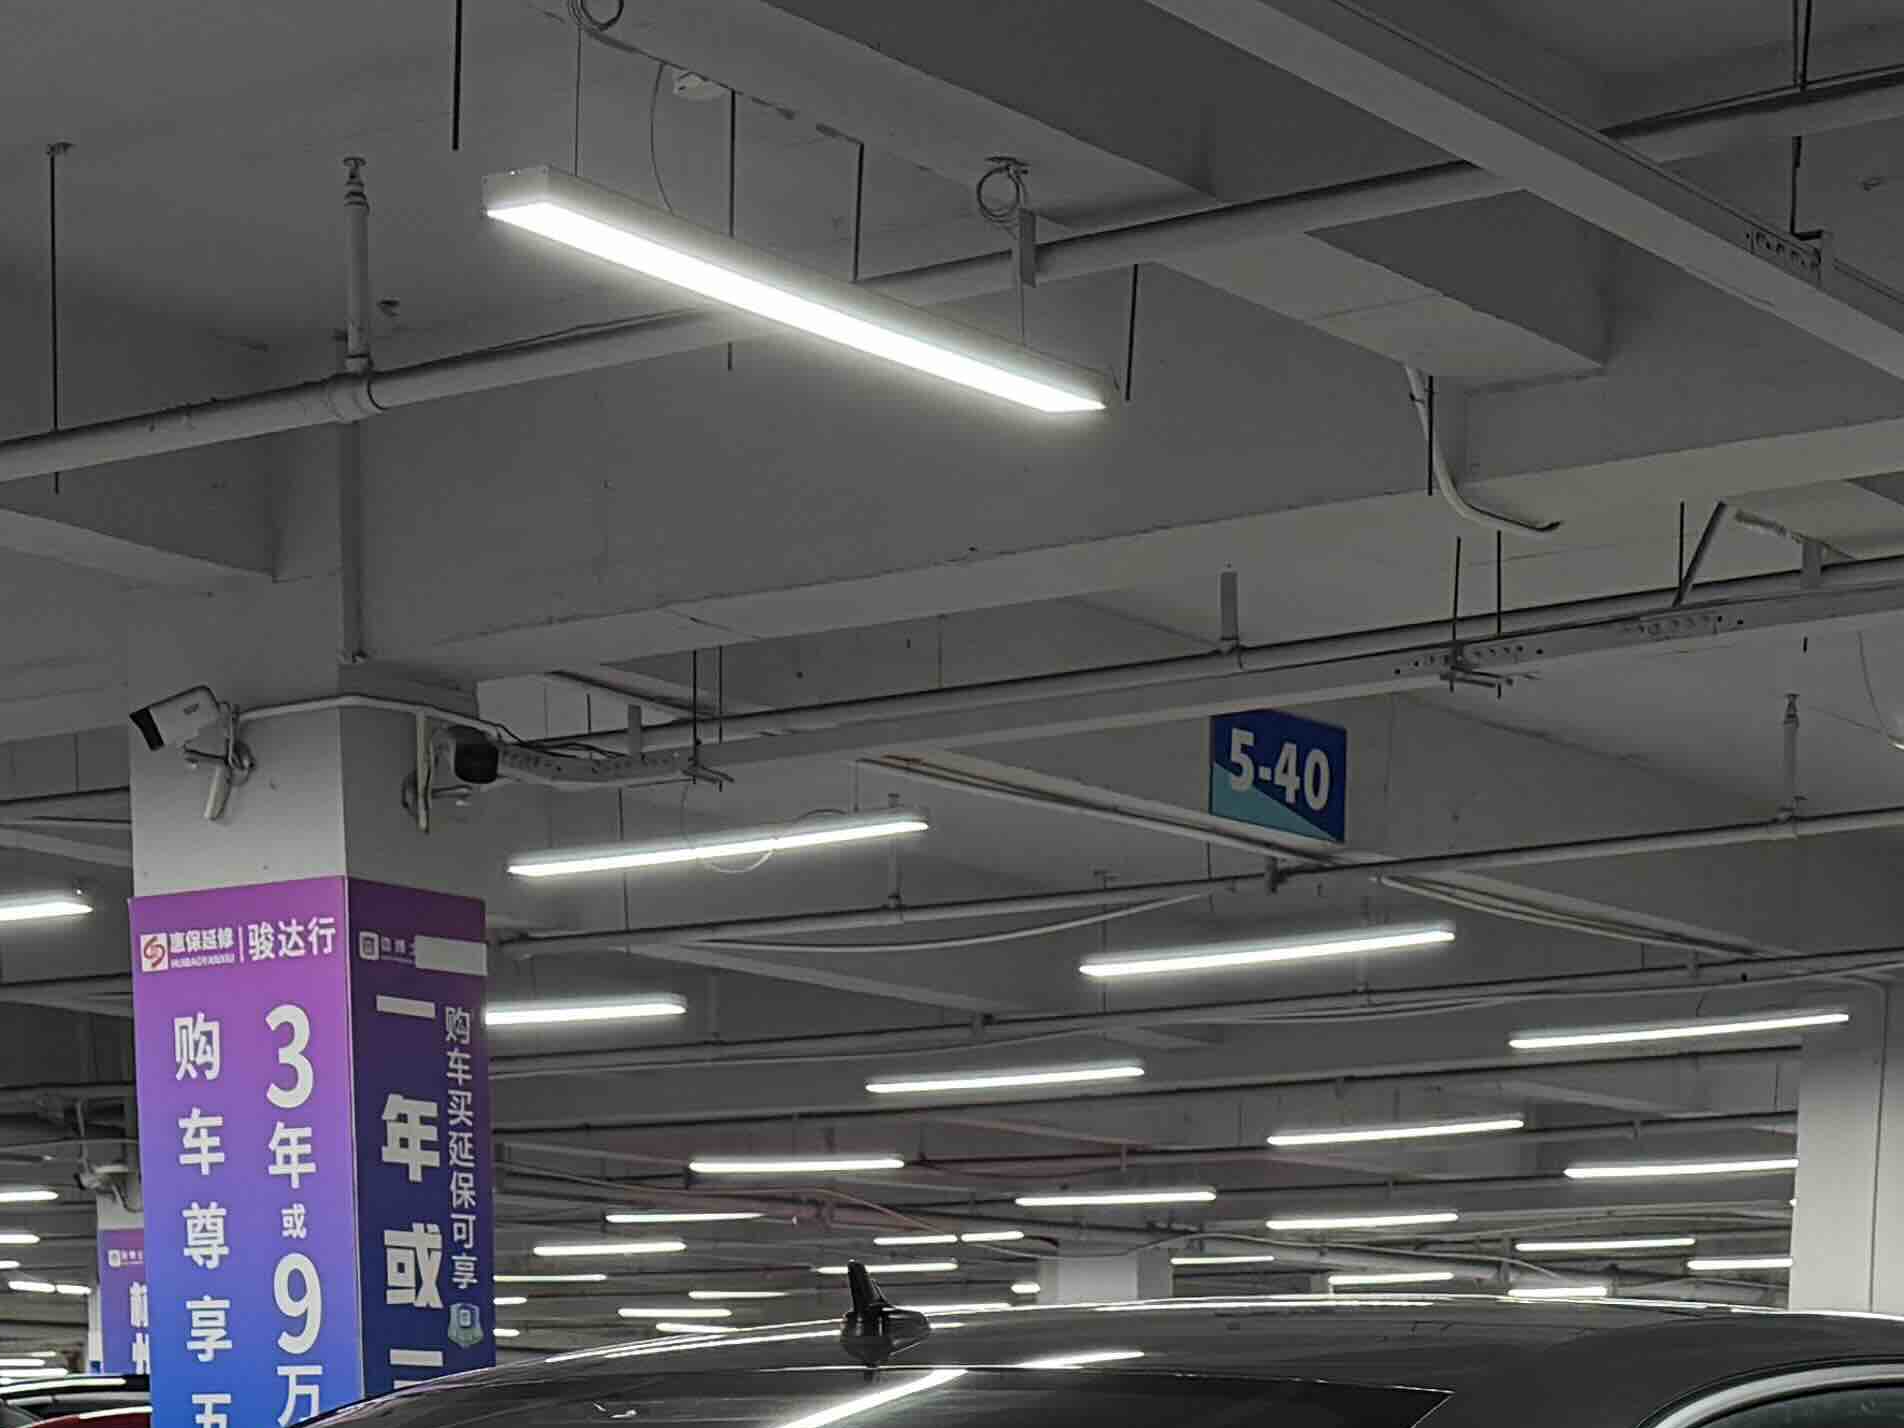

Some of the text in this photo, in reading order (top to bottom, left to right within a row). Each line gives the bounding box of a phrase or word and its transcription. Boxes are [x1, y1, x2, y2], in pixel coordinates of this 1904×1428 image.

[247, 916, 336, 961] 骏达行
[443, 1006, 479, 1290] 购车买延保可享
